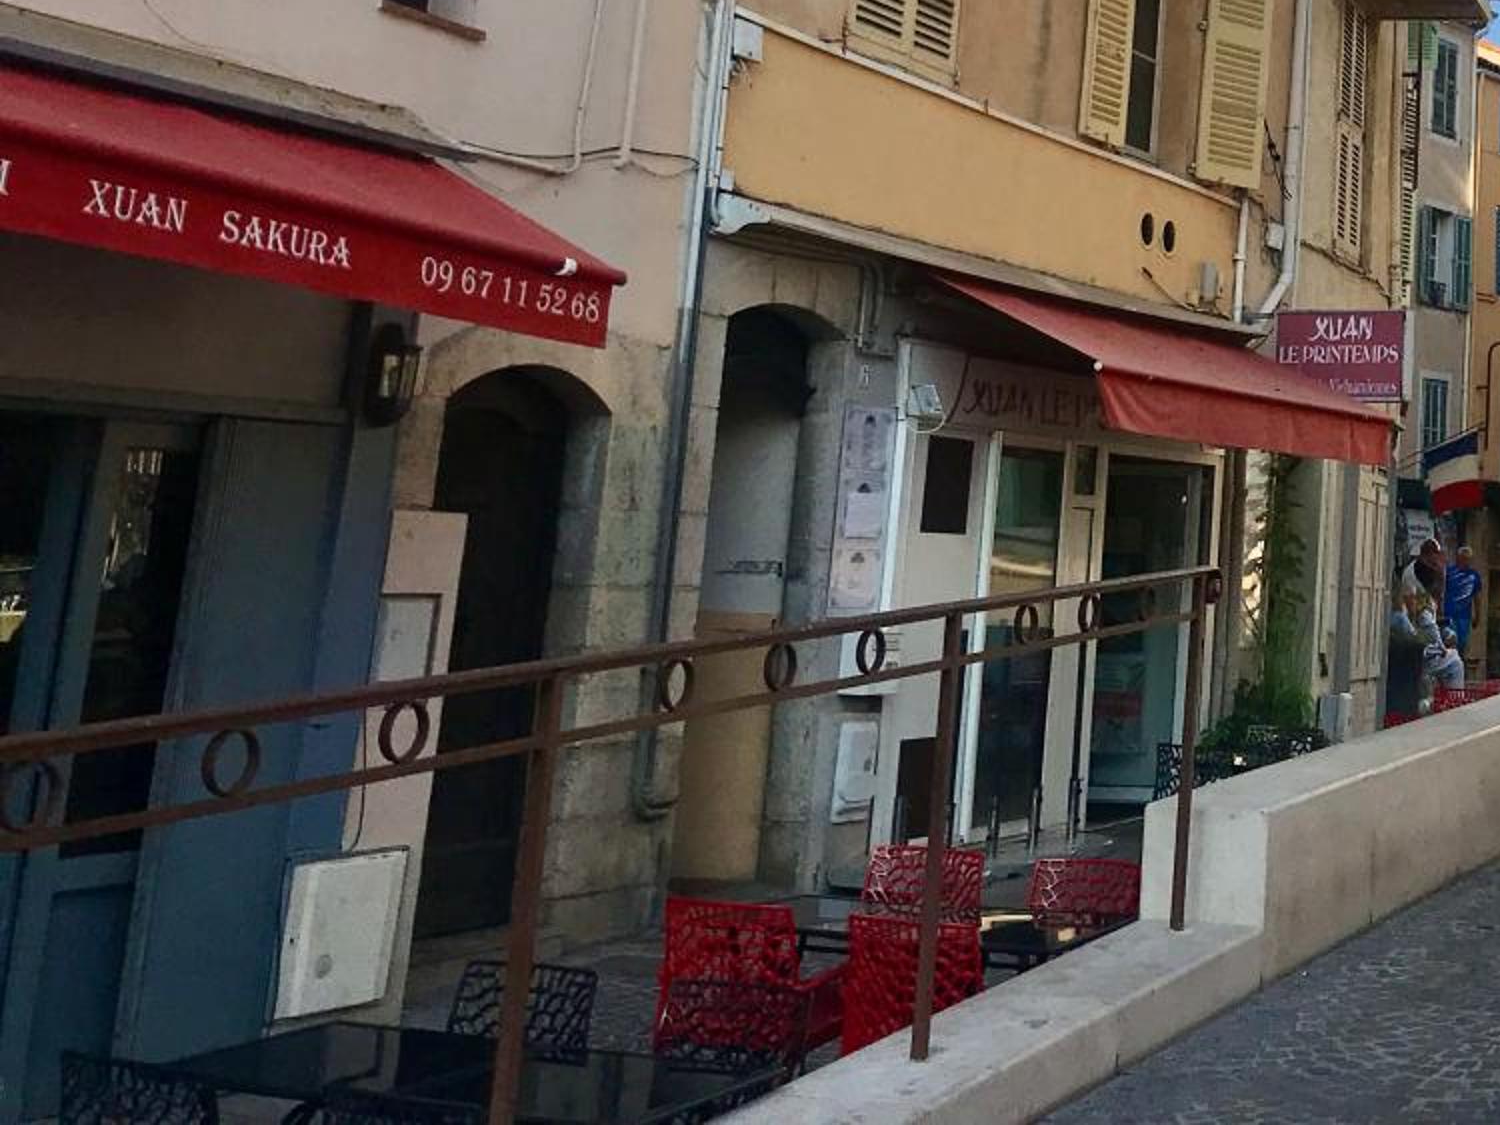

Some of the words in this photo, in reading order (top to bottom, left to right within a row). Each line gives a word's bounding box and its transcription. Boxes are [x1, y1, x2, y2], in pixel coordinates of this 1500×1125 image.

[82, 179, 188, 233] XUAN
[219, 210, 352, 268] SAKURA
[421, 256, 453, 292] 09
[461, 266, 493, 299] 67
[503, 277, 528, 307] 11
[536, 284, 567, 315] 52
[571, 291, 599, 323] 68
[1307, 315, 1373, 342] XUAN
[1280, 346, 1300, 364] LE
[1303, 345, 1399, 364] PRINTEMPS
[962, 378, 1034, 420] XUAN
